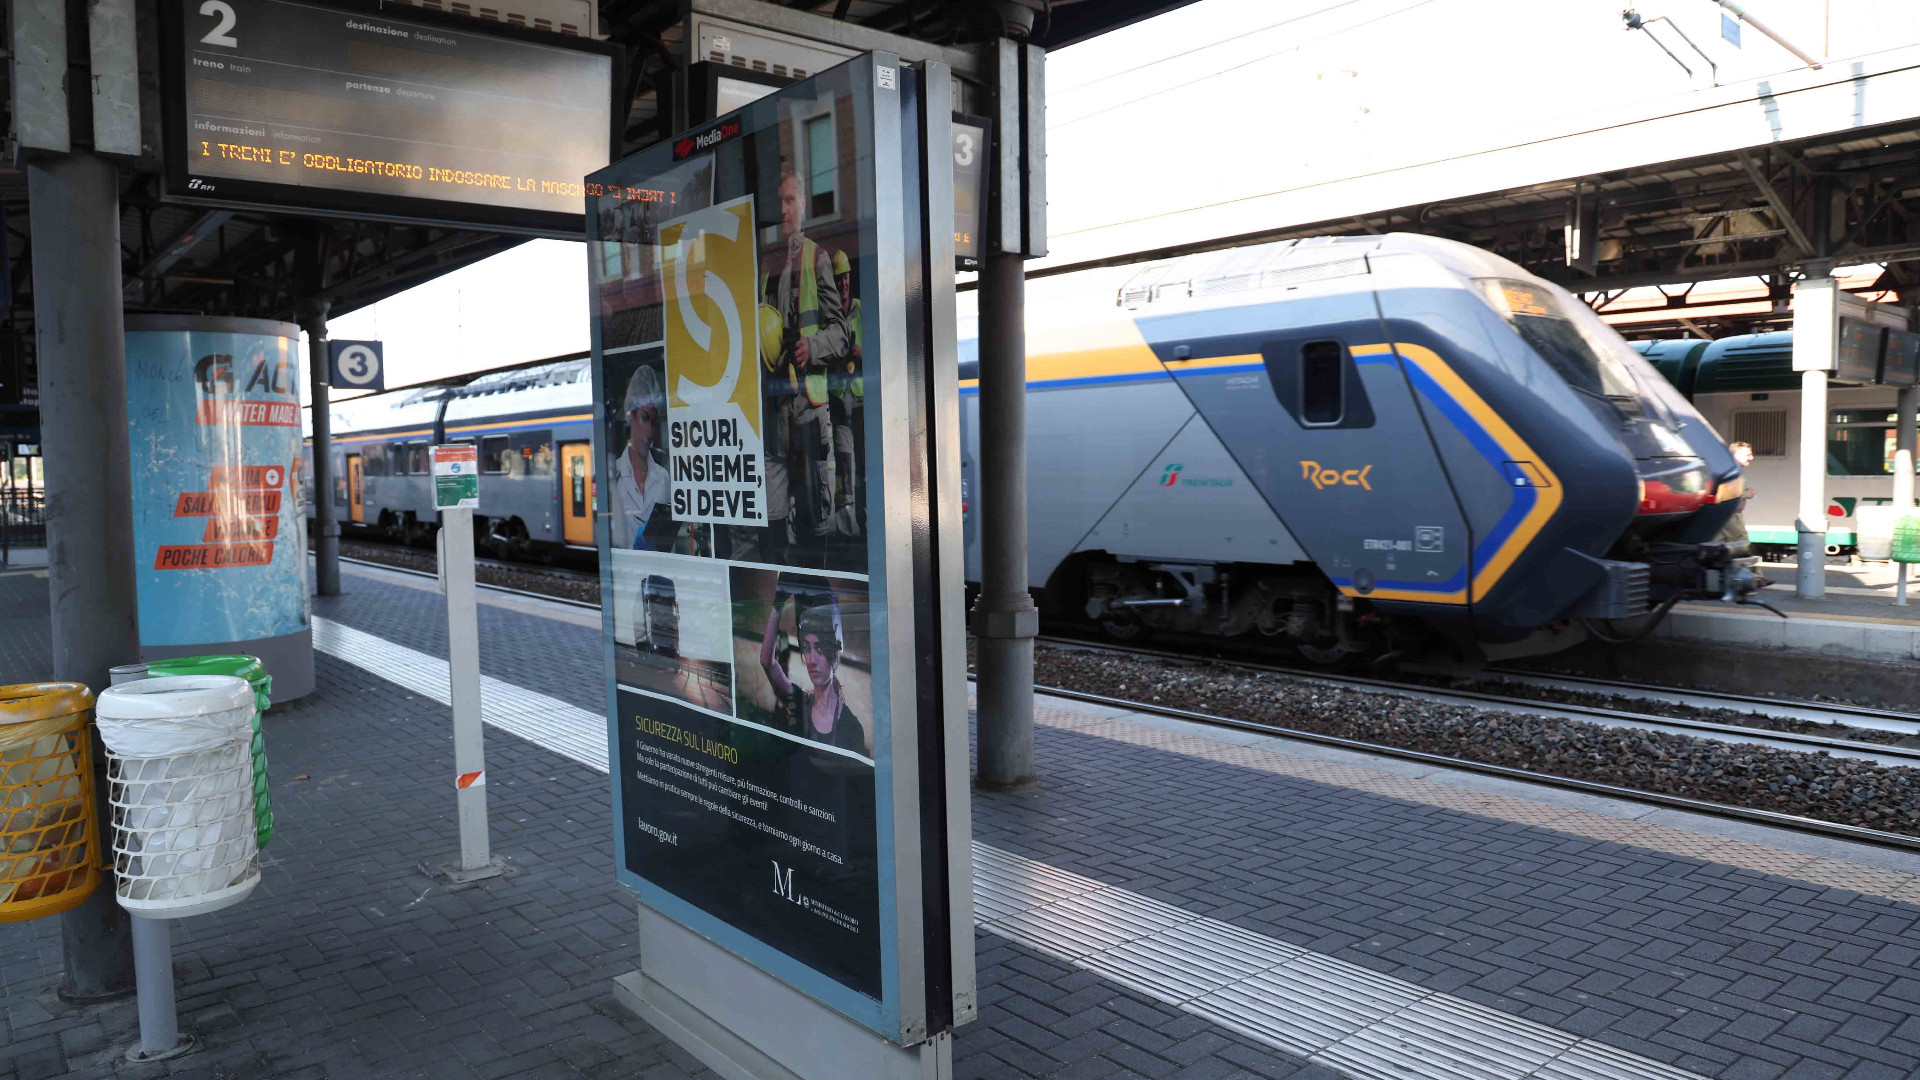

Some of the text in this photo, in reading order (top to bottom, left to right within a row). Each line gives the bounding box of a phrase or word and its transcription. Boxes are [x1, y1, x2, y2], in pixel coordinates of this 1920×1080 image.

[199, 0, 238, 48] 2
[346, 20, 457, 46] destinazione destination
[193, 57, 251, 74] treno train
[346, 81, 436, 101] partenza departure
[194, 120, 321, 144] informazioni information
[696, 122, 739, 150] MediaOne
[201, 141, 210, 157] I
[954, 133, 974, 167] 3
[347, 351, 369, 377] 3
[671, 418, 744, 452] SICURI,
[673, 454, 762, 489] INSIEME,
[674, 488, 762, 520] SI DEVE.
[162, 548, 209, 566] POCHE
[635, 715, 738, 765] SICUREZZA SUL LAVORO
[746, 780, 779, 803] formazione,
[780, 794, 803, 811] controlli
[638, 816, 677, 846] lavoro.gov.it
